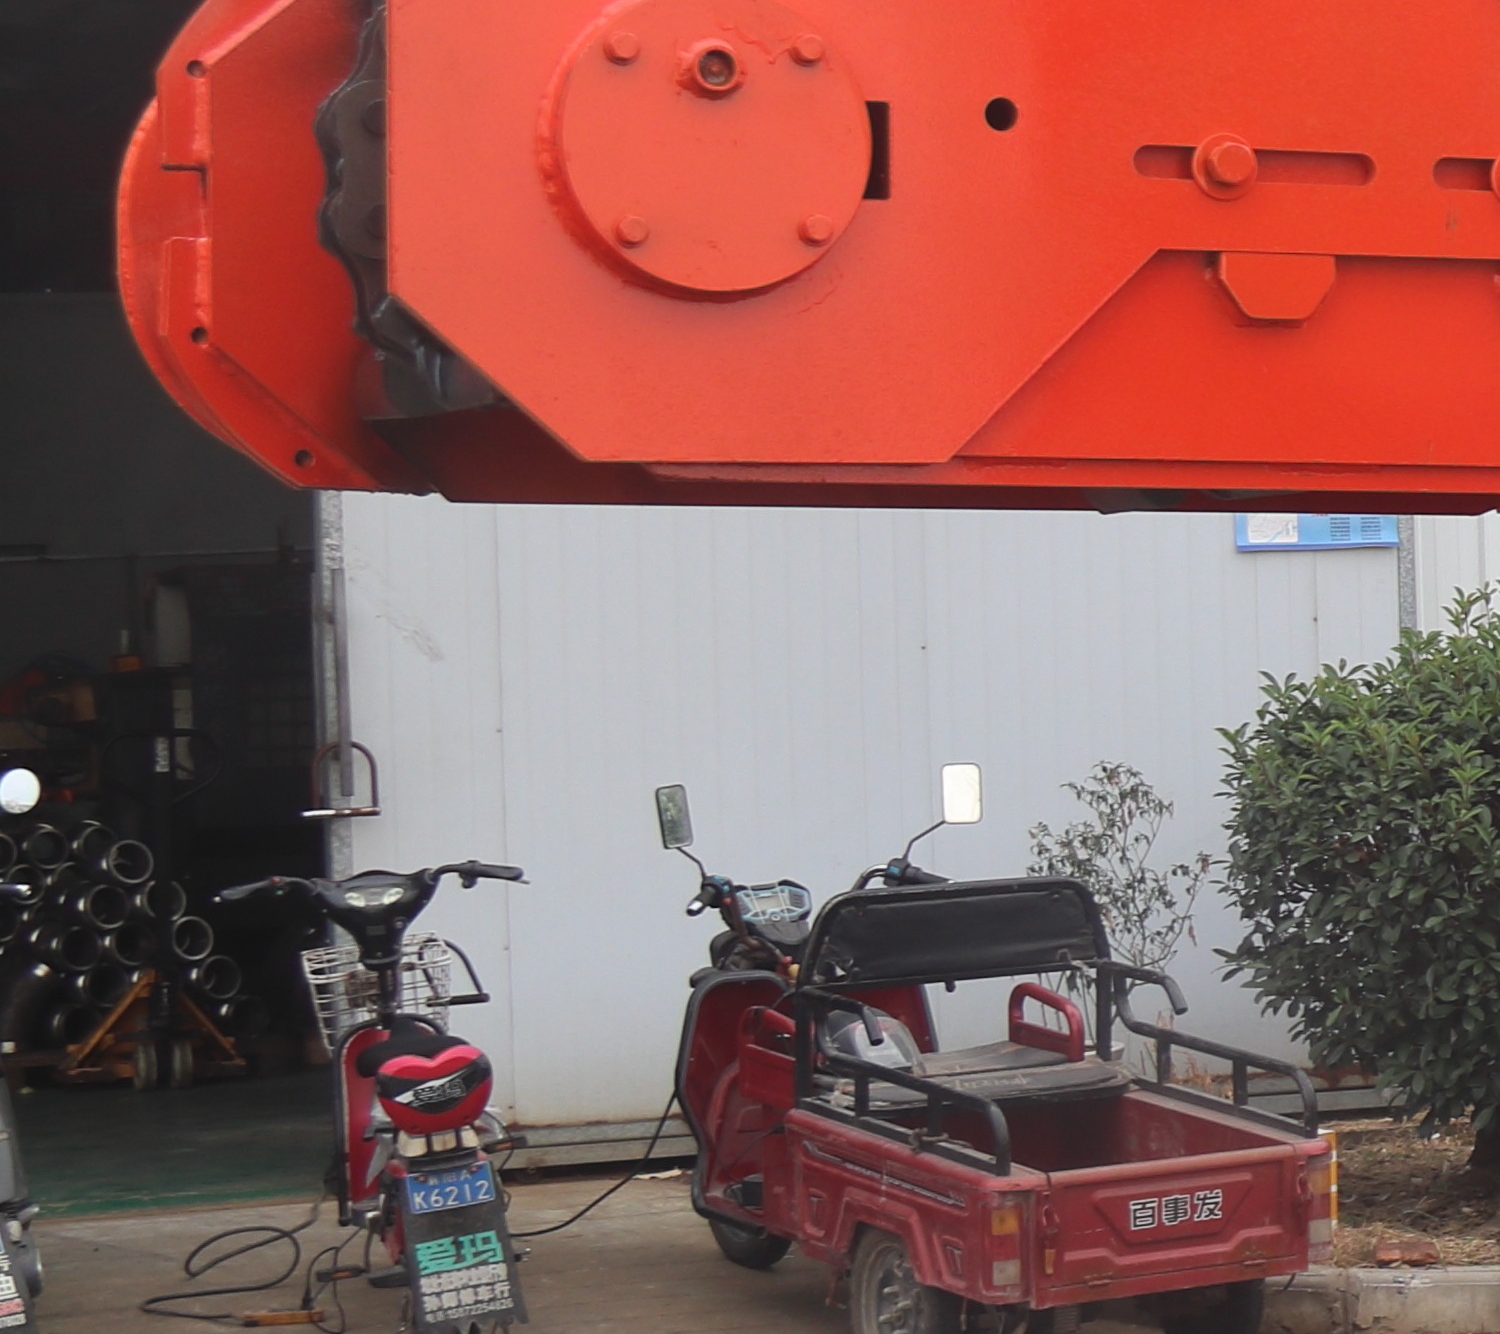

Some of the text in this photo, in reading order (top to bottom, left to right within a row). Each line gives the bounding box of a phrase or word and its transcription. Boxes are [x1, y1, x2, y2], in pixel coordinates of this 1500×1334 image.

[413, 1180, 491, 1210] K6212
[1129, 1189, 1222, 1230] 百事发
[415, 1230, 505, 1276] 爱玛
